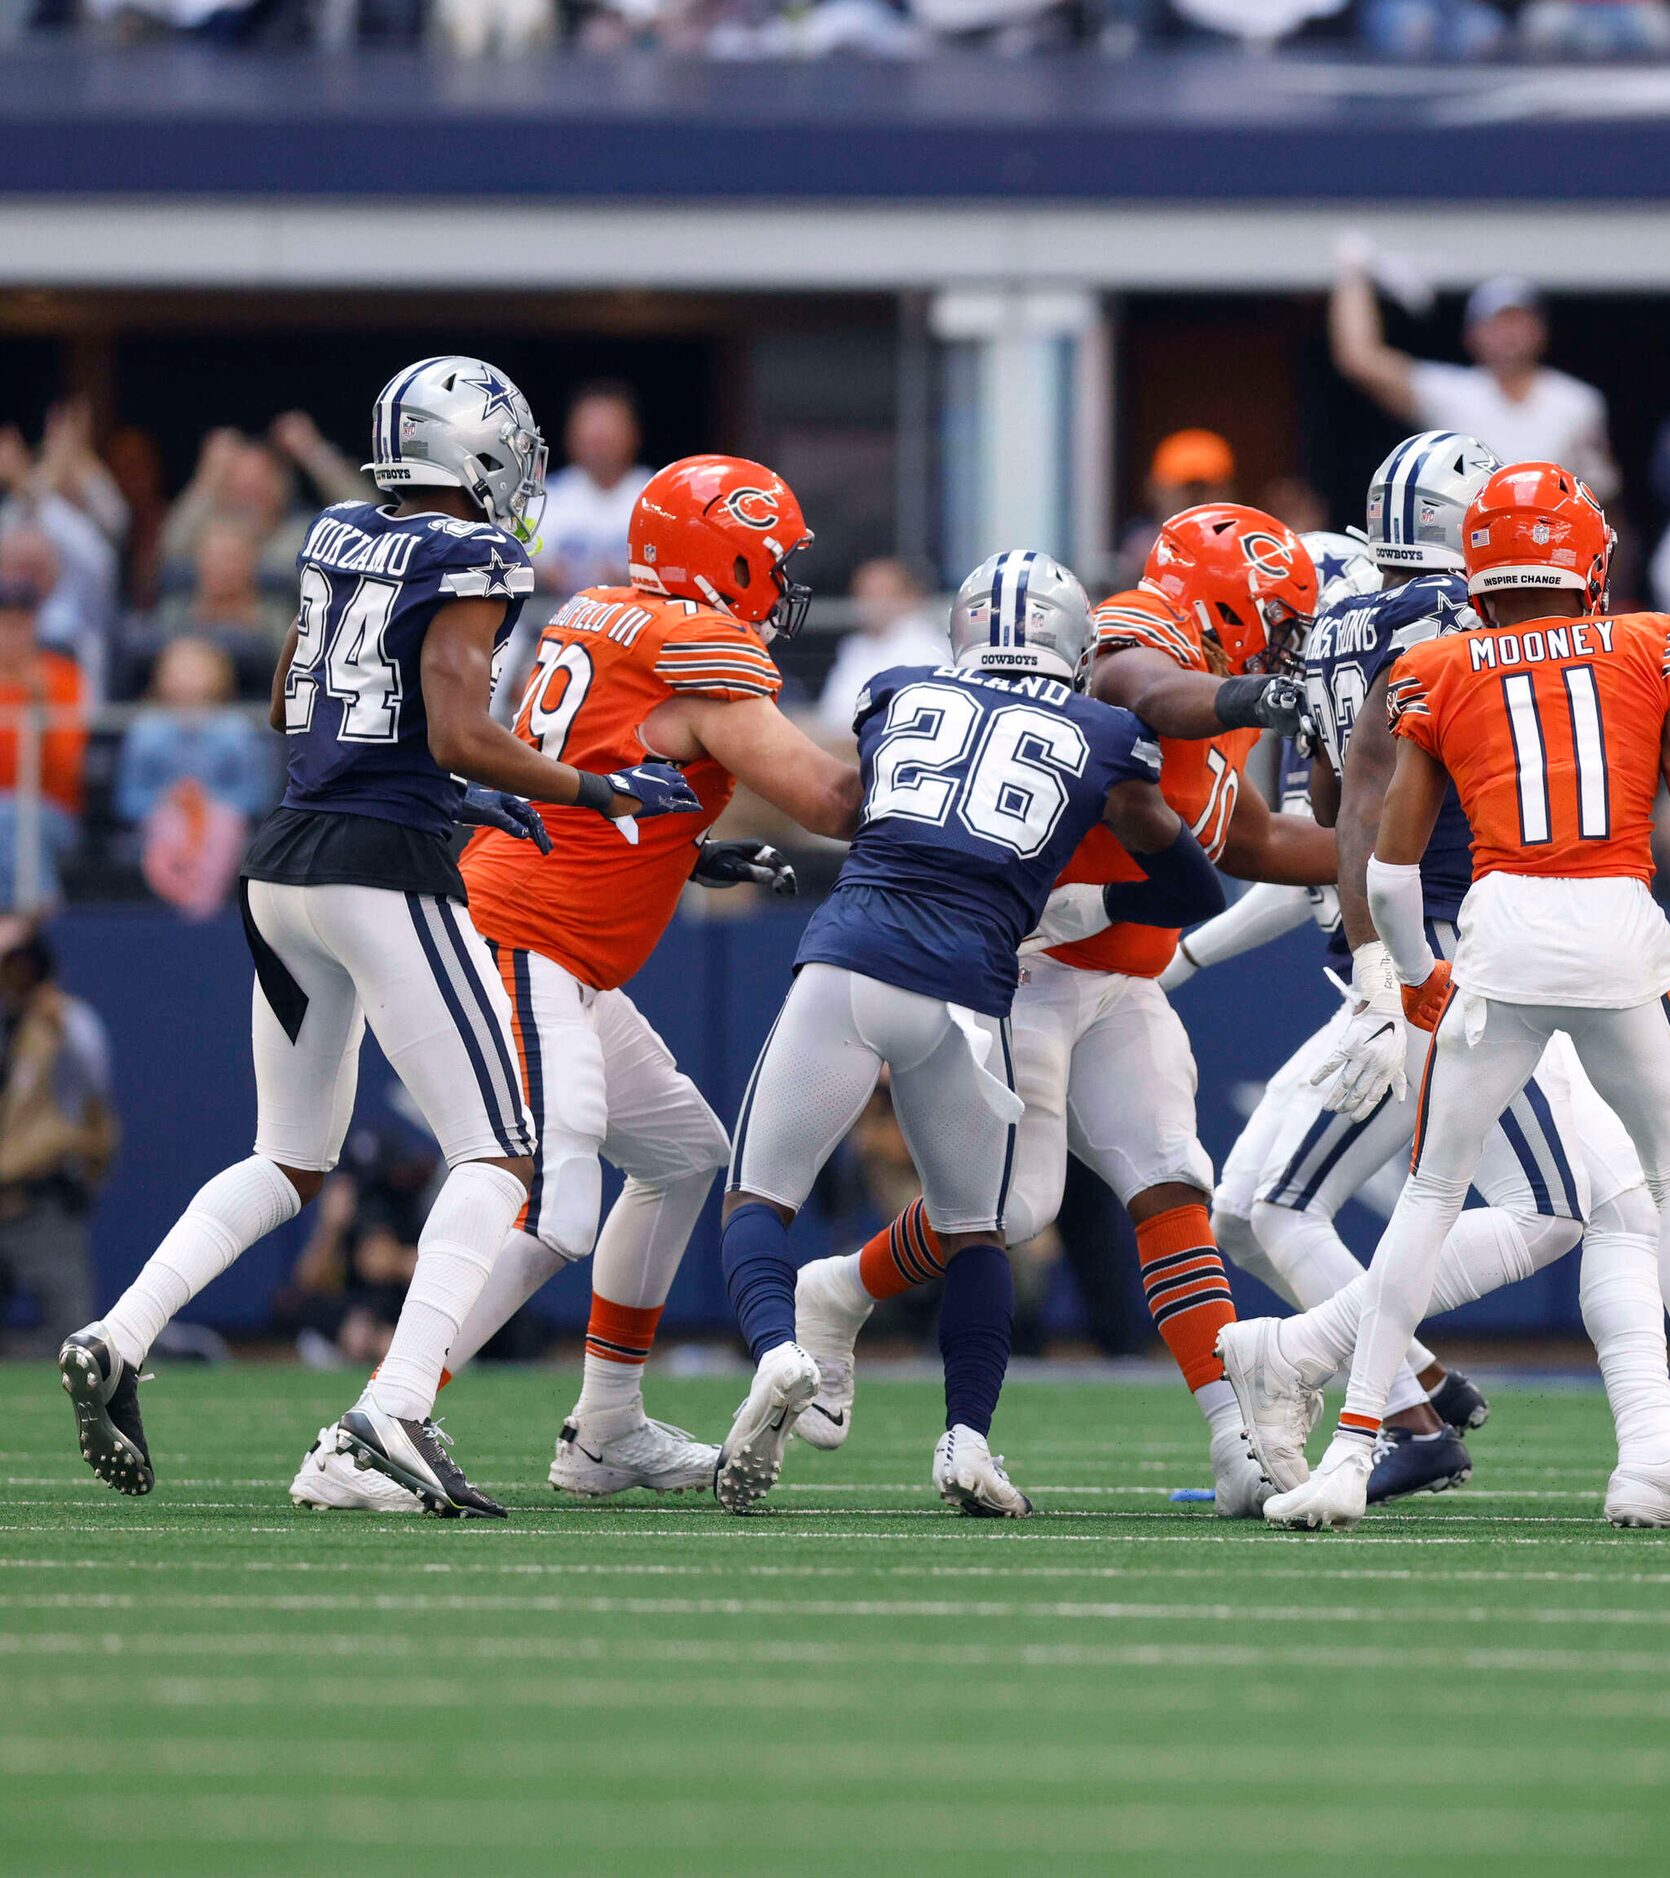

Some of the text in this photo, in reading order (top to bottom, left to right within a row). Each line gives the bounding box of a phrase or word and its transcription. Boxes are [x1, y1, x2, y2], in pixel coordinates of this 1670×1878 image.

[1376, 547, 1423, 560] COWBOYS
[1484, 575, 1562, 587] INSPIRE CHANGE
[284, 561, 404, 744] 24
[981, 654, 1038, 666] COWBOYS
[1468, 619, 1615, 672] MOONEY
[865, 682, 1090, 860] 26
[1500, 663, 1611, 847] 11
